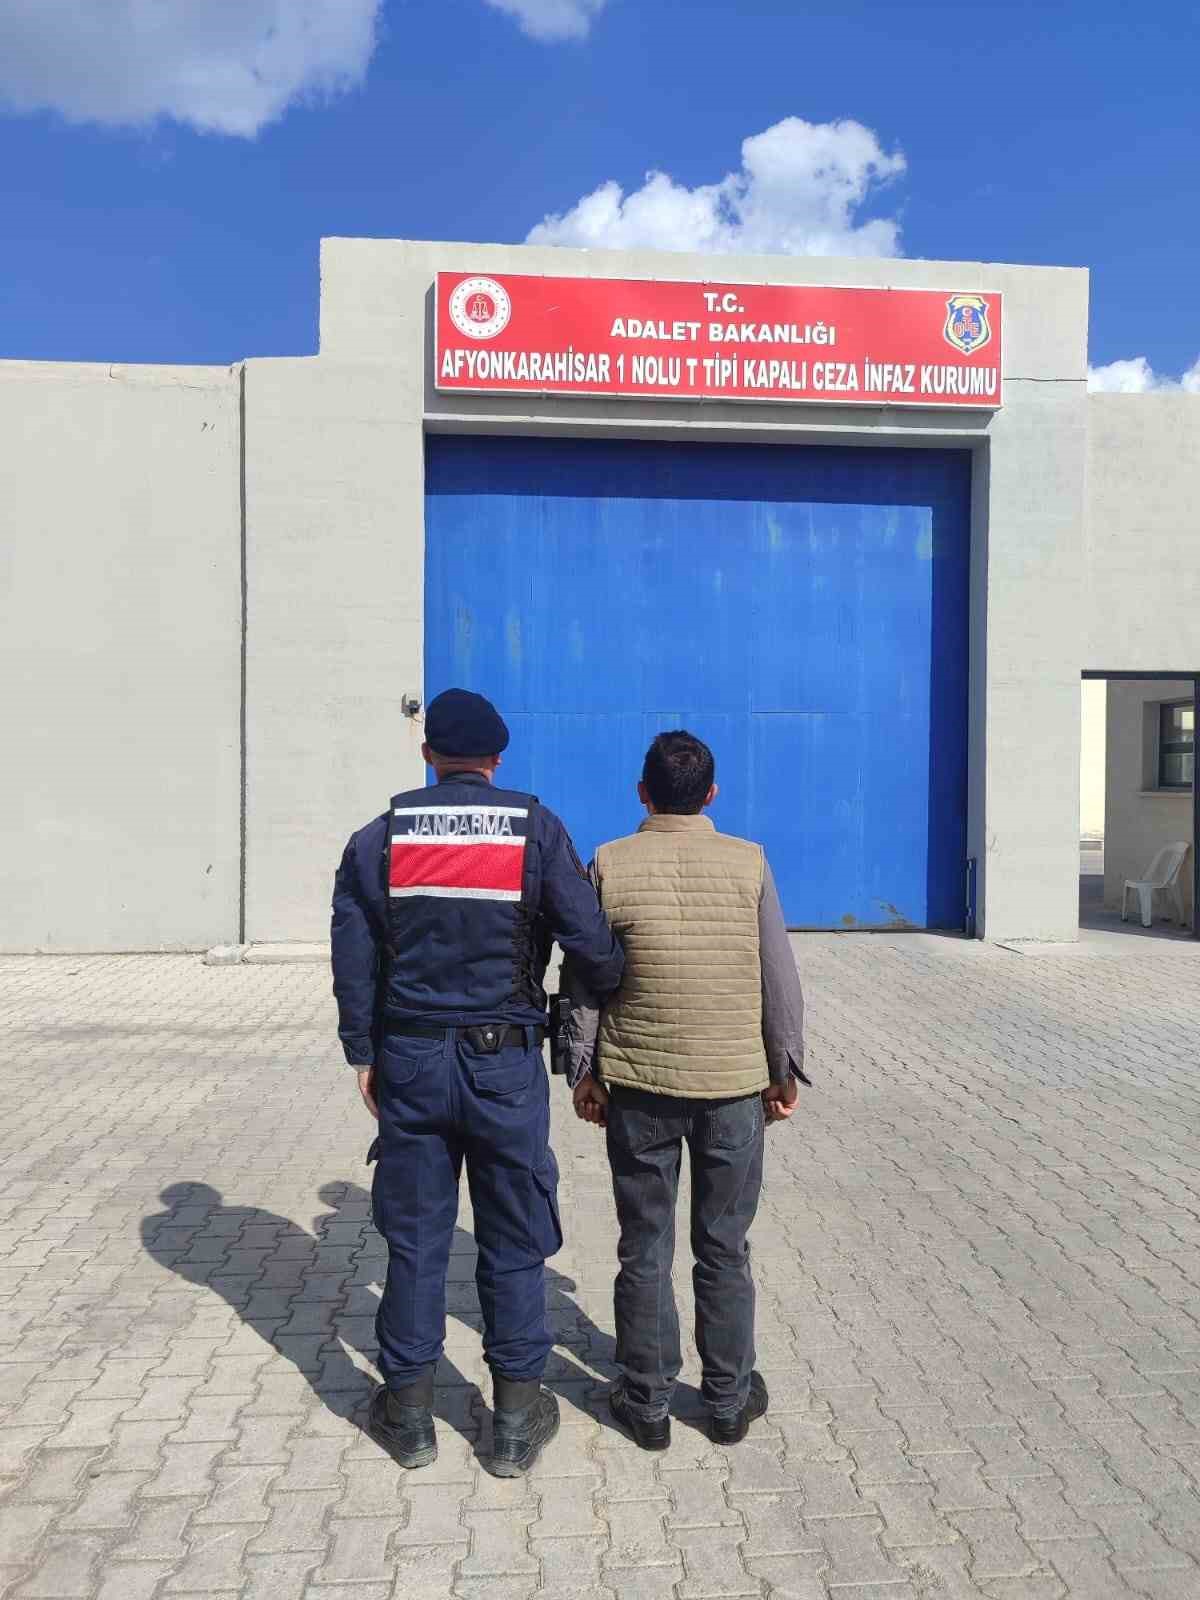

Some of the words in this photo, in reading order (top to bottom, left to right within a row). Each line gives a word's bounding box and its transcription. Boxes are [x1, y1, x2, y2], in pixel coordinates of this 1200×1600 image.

[703, 292, 745, 312] T.C.
[610, 318, 701, 341] ADALET
[708, 321, 836, 345] BAKANLIĞI
[441, 344, 611, 383] AFYONKARAHİSAR
[616, 354, 625, 383] 1
[631, 355, 681, 386] NOLU
[686, 358, 698, 387] T
[703, 352, 737, 388] TİPİ
[743, 359, 807, 391] KAPALI
[812, 361, 859, 392] CEZA
[864, 357, 915, 394] İNFAZ
[920, 365, 997, 396] KURUMU
[408, 815, 513, 836] JANDARMA
